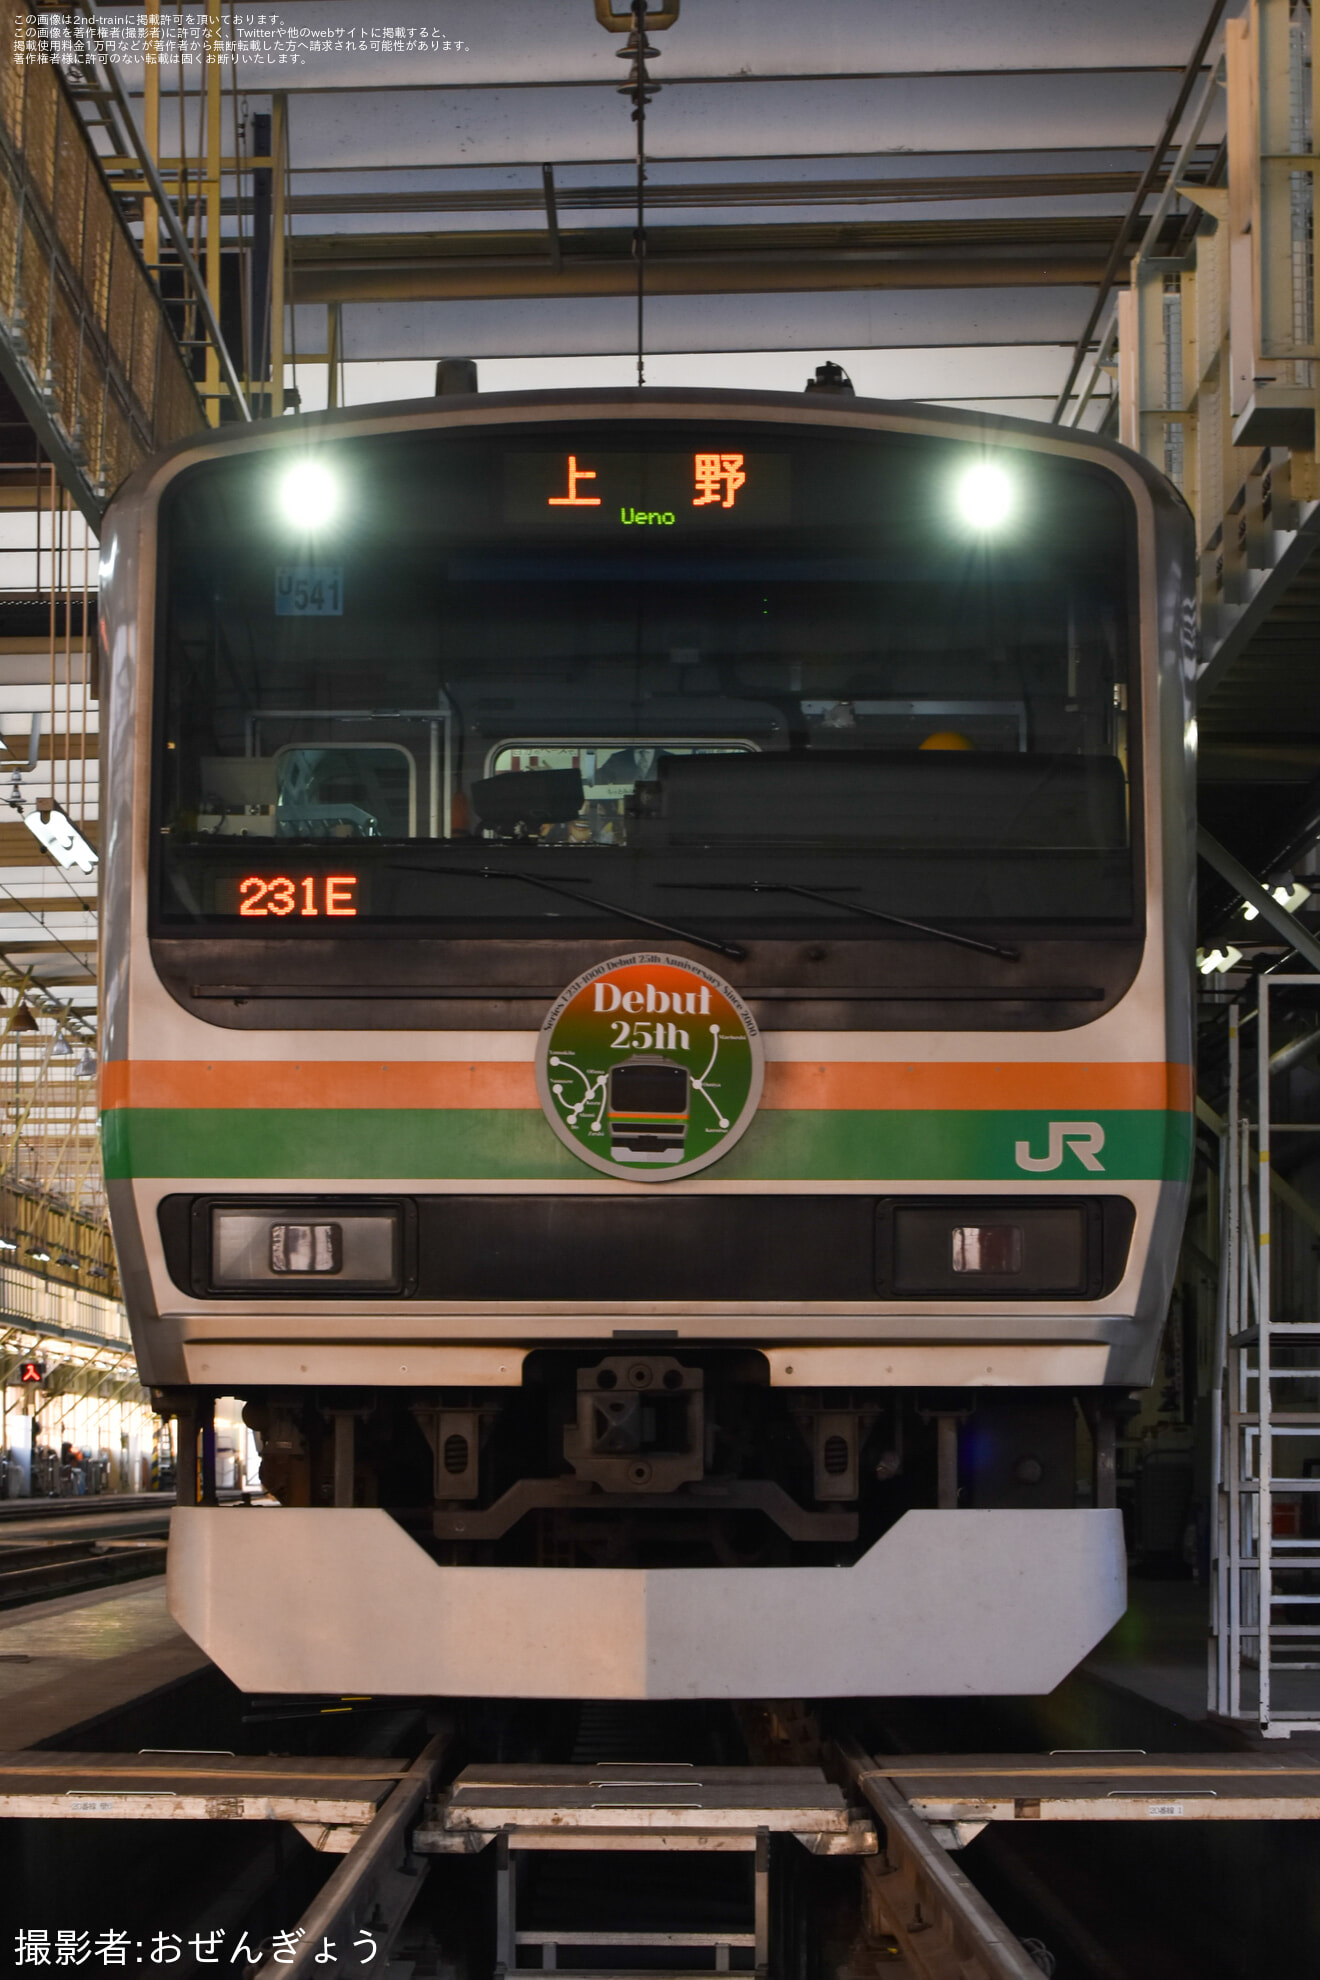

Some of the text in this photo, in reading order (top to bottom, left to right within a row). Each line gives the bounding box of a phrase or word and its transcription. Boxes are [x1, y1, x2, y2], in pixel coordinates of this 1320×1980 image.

[620, 507, 676, 525] Ueno
[239, 877, 357, 916] 231E
[543, 1003, 565, 1031] Series
[606, 956, 637, 971] Debut
[638, 954, 661, 964] 25th
[664, 956, 722, 988] Anniversary
[723, 985, 743, 1010] Since
[741, 1010, 758, 1037] 2000
[593, 982, 713, 1015] Debut
[610, 1020, 691, 1051] 25th
[1015, 1122, 1106, 1172] JR
